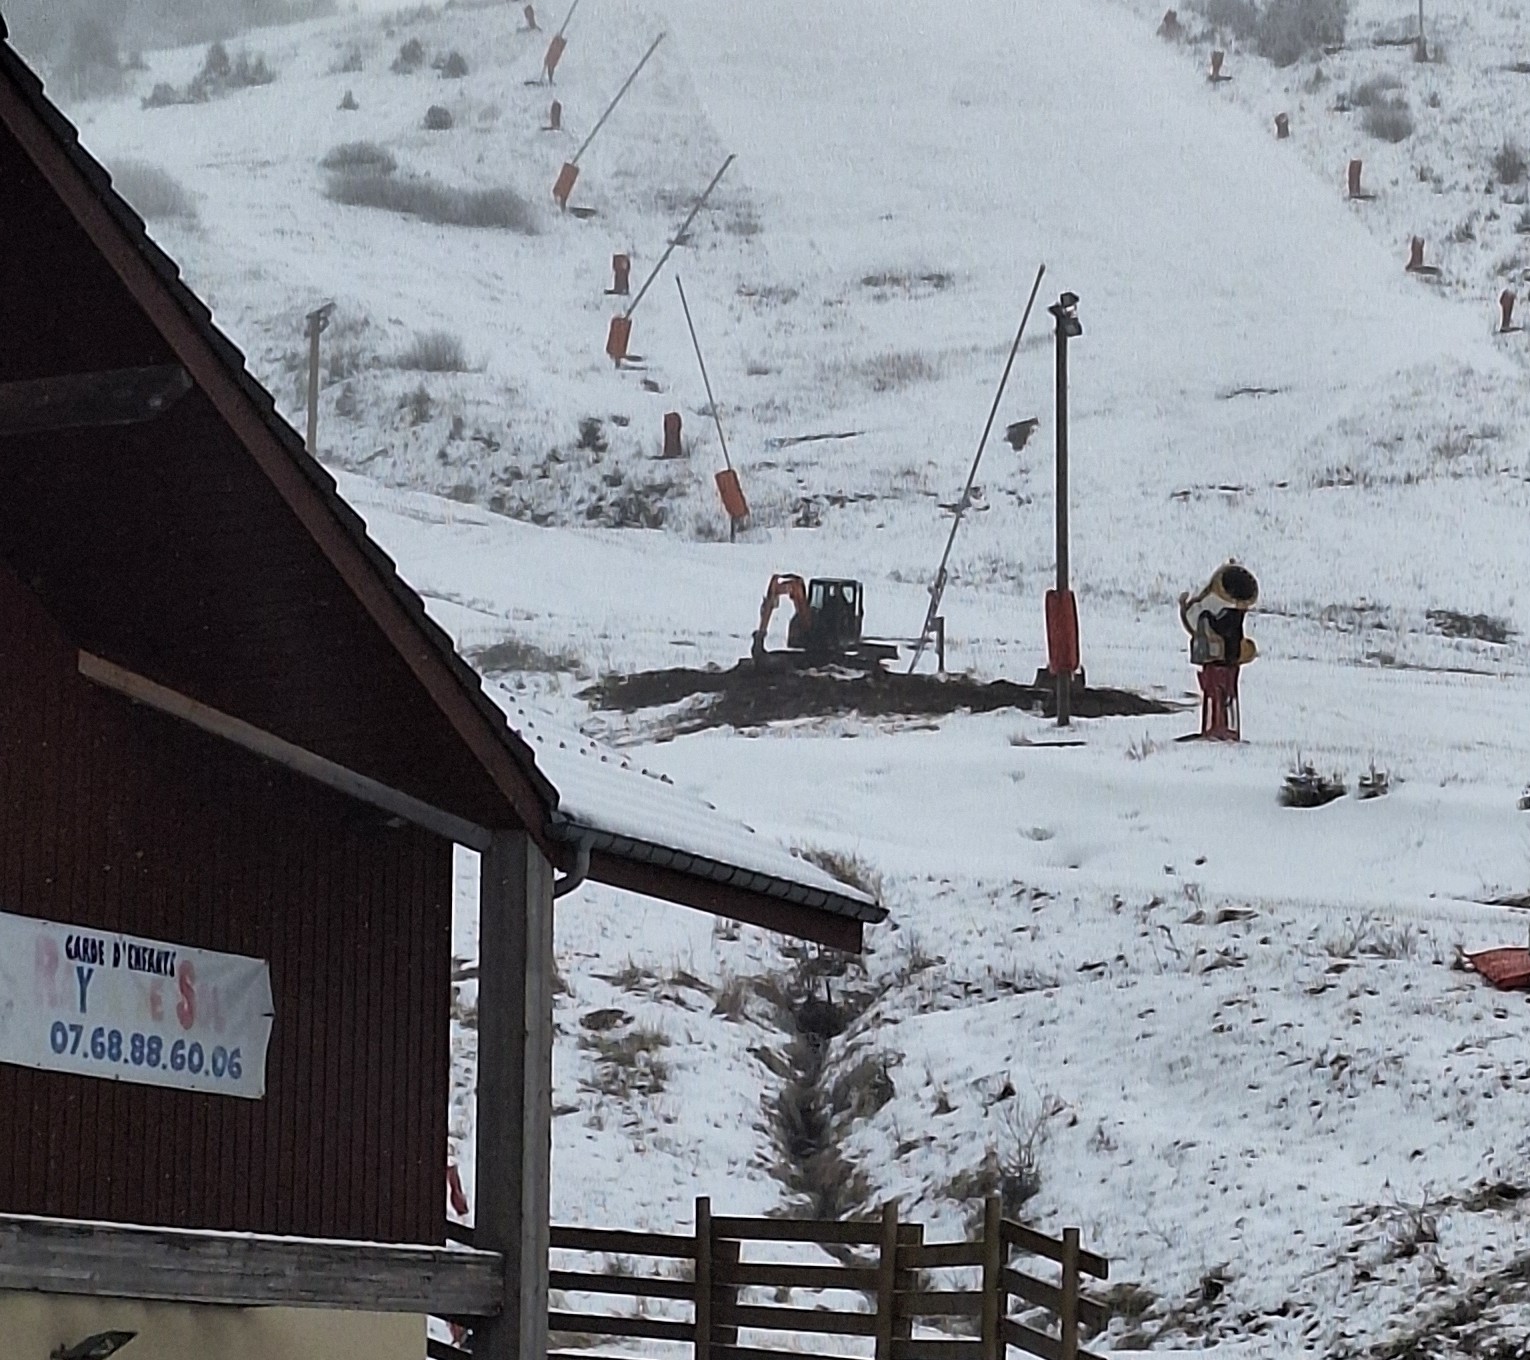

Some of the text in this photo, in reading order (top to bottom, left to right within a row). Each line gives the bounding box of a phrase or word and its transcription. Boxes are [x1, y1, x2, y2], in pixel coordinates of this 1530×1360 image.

[65, 934, 105, 966] GARDE
[112, 940, 177, 978] D'ENFANTS
[50, 1021, 243, 1080] 07.68.88.60.06
